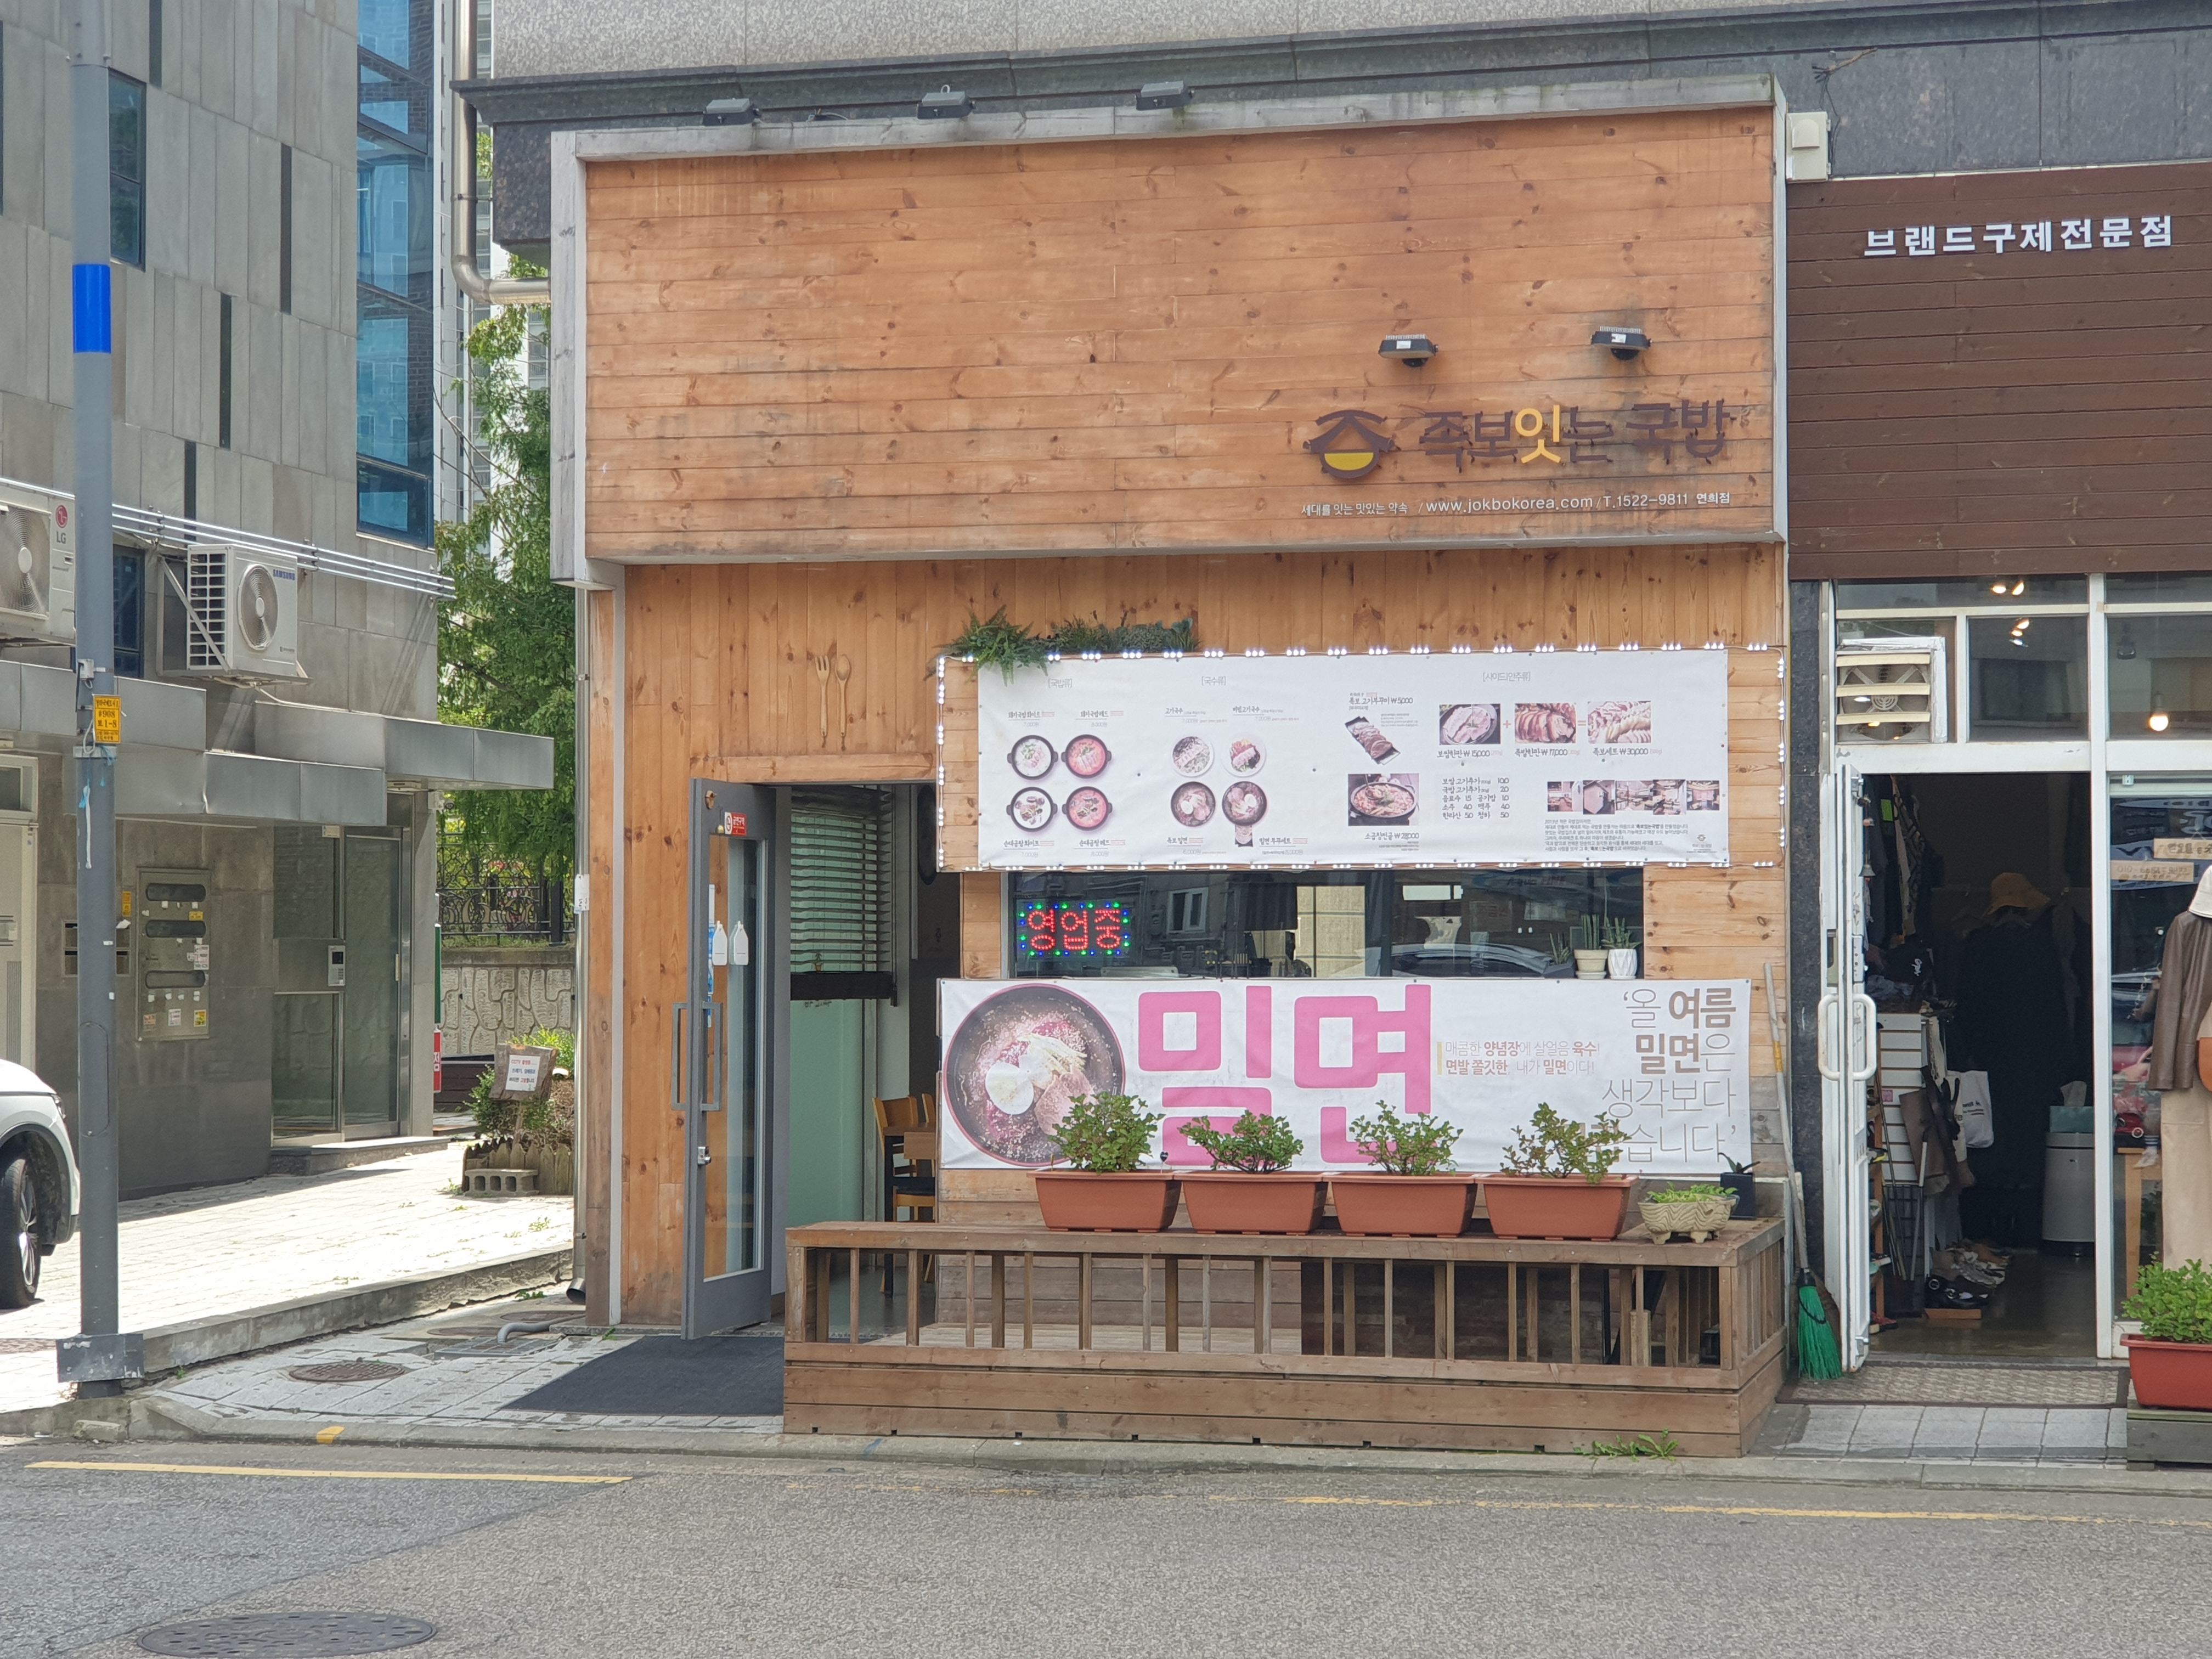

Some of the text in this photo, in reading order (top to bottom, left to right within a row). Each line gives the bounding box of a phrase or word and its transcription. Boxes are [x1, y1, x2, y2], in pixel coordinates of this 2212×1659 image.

[1864, 215, 2171, 256] 브랜드구제전문점
[1419, 400, 1731, 470] 족보잇는 국밥
[1301, 504, 1331, 516] 세대를
[1333, 503, 1353, 515] 잇는
[1356, 503, 1385, 515] 맛있는
[1388, 501, 1408, 514] 약속
[1426, 496, 1593, 514] www.jokbokorea.com
[1603, 493, 1688, 509] T.1522-9811
[1696, 492, 1730, 505] 연희점
[57, 531, 66, 544] LG
[273, 569, 295, 580] SAMSUNG
[1514, 748, 1540, 757] 족발한판
[1593, 747, 1619, 757] 족보세트
[1442, 777, 1455, 785] 보쌈
[1442, 786, 1455, 794] 국밥
[1442, 794, 1461, 803] 음료수
[1477, 794, 1497, 802] 공기밥
[1442, 811, 1462, 820] 한라산
[1028, 909, 1121, 951] 영업중
[1668, 988, 1736, 1029] 여름
[1445, 1041, 1481, 1057] 매콤한
[1483, 1041, 1531, 1057] 양념장에
[1534, 1040, 1571, 1057] 살얼음
[1635, 1033, 1735, 1075] 밀면은
[1138, 984, 1431, 1165] 밀면
[1446, 1059, 1470, 1075] 면발
[1516, 1059, 1541, 1075] 내가
[1543, 1059, 1595, 1075] 밀면이다!
[1602, 1078, 1736, 1119] 생각보다
[1560, 1122, 1736, 1163] 습니다'
